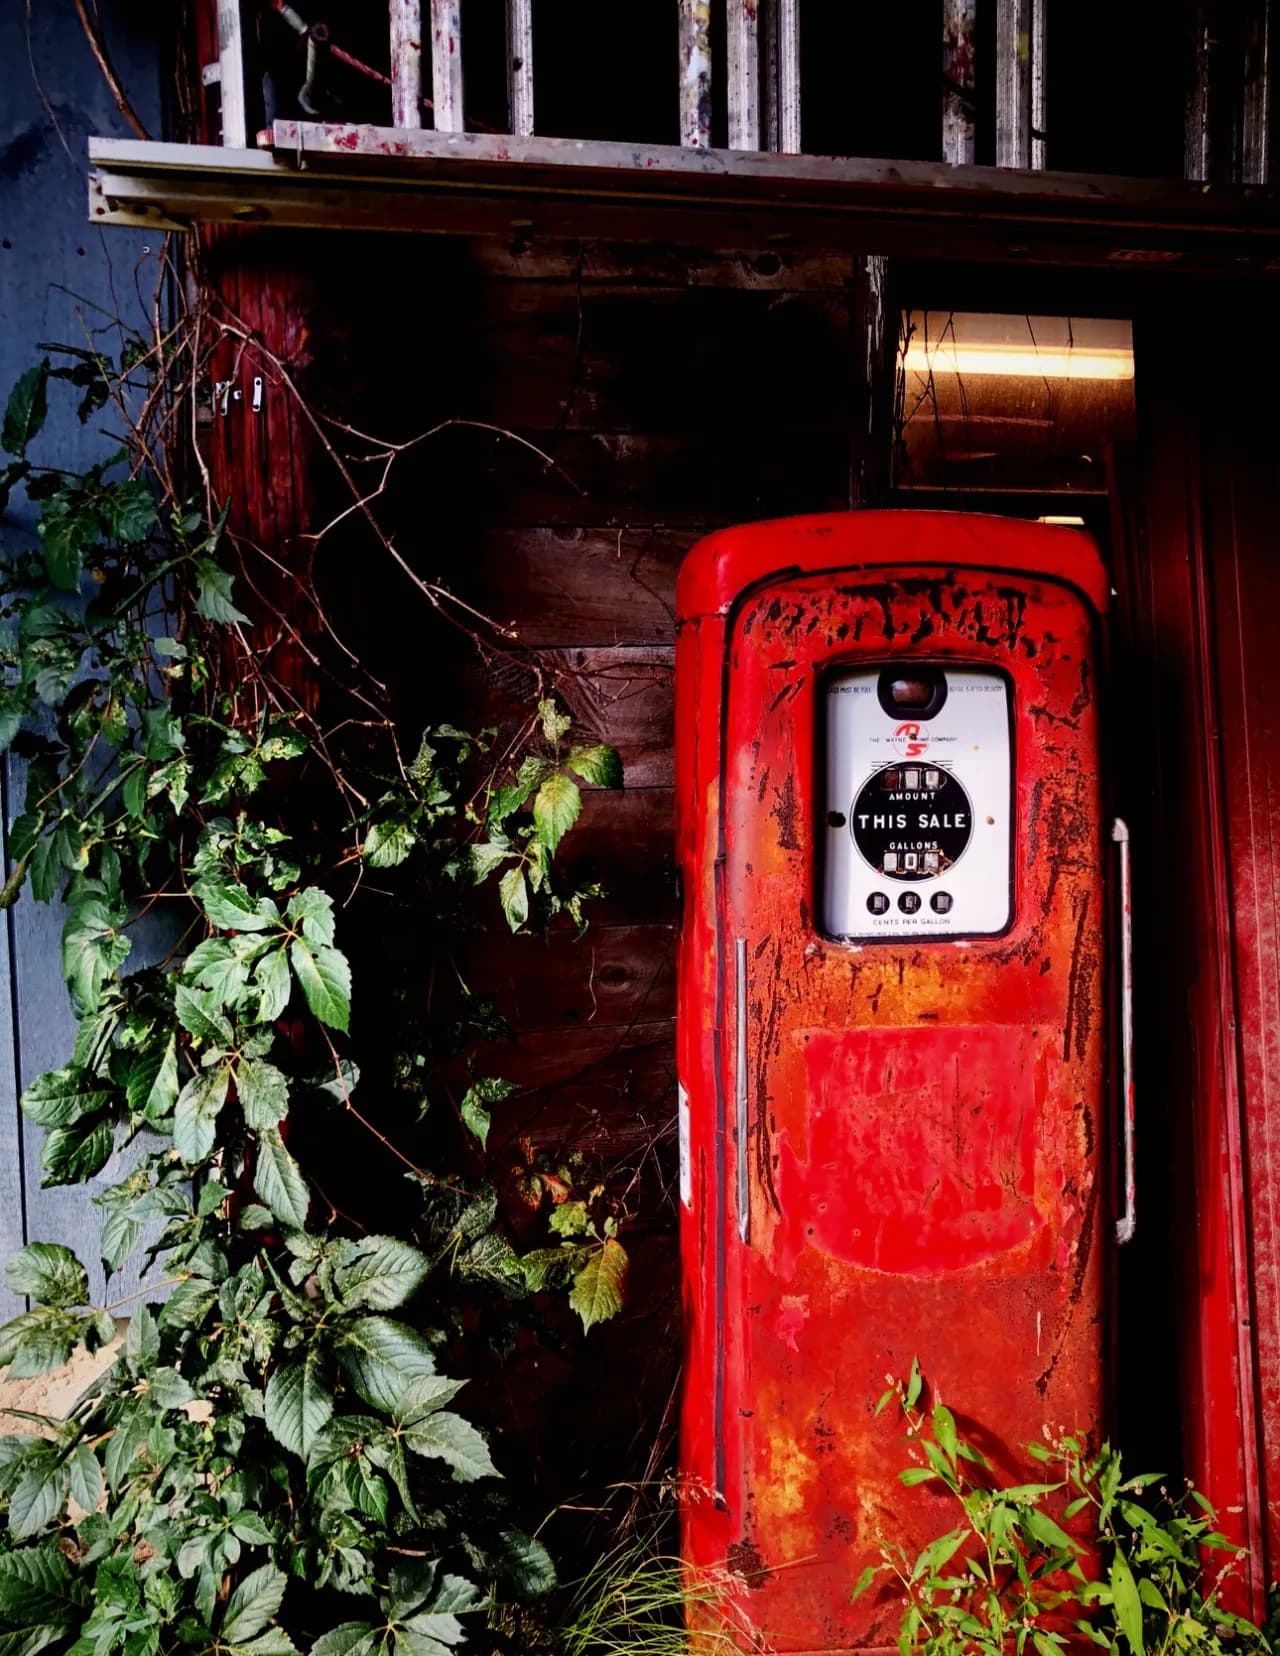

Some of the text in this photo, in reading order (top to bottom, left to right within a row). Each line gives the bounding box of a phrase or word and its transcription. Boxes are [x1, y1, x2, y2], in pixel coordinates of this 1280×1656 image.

[889, 792, 936, 801] AMOUNT
[858, 813, 966, 830] THIS SALE
[889, 841, 938, 850] GALLONS
